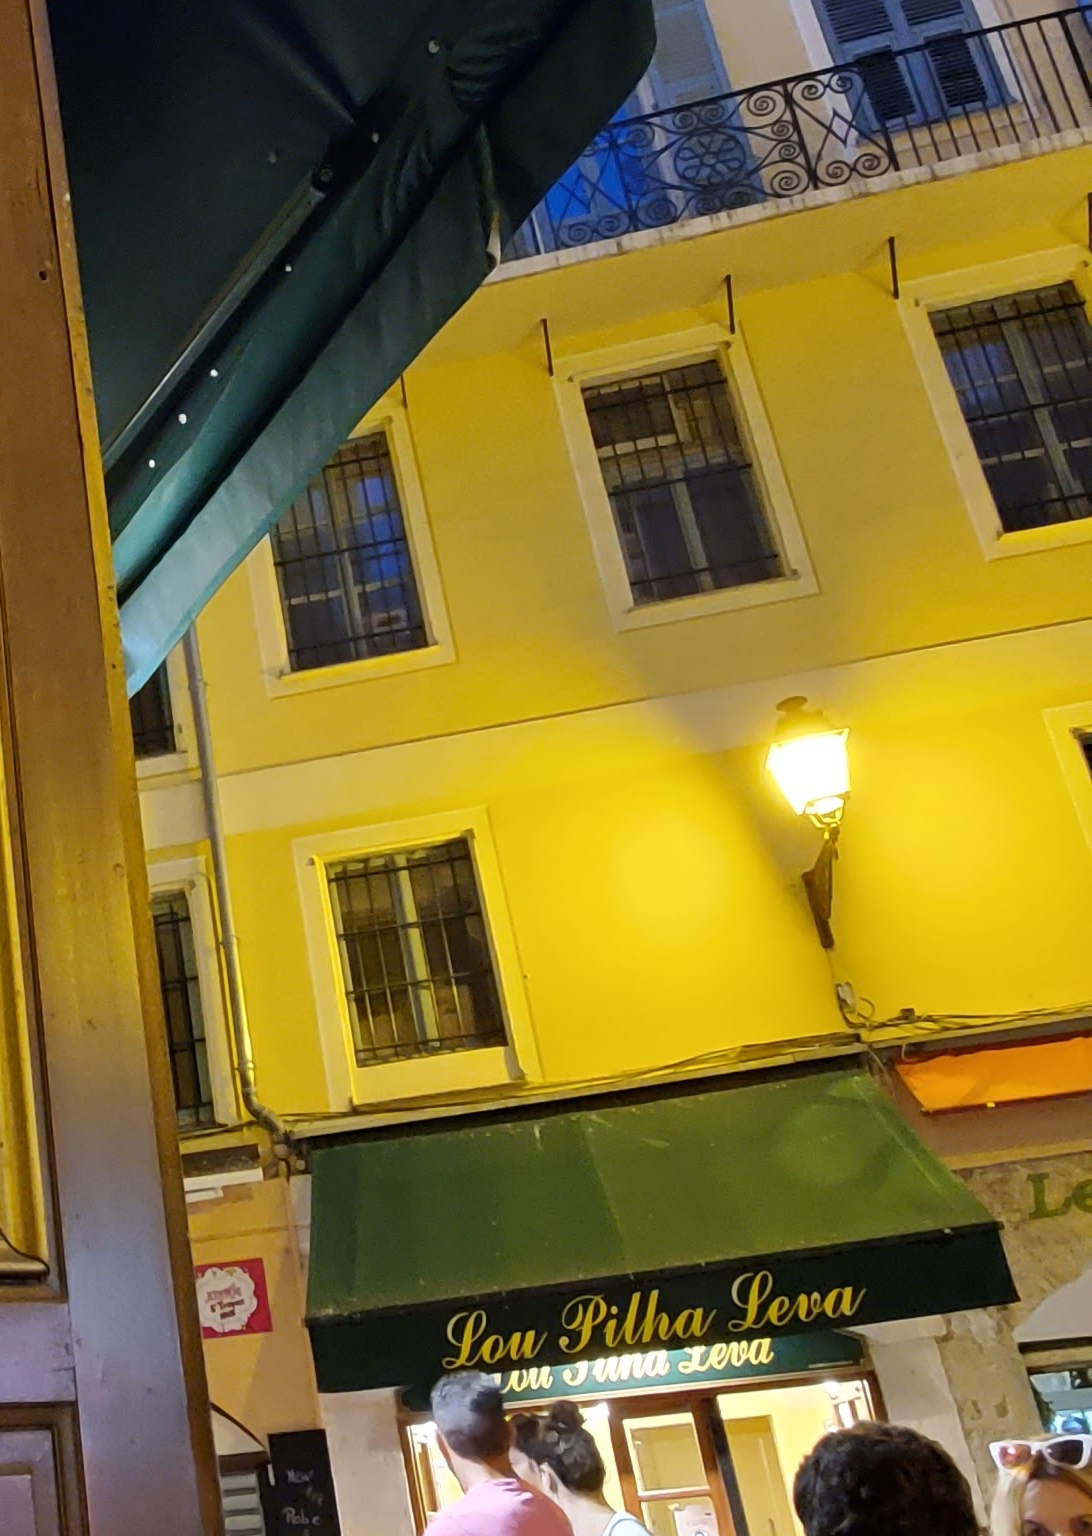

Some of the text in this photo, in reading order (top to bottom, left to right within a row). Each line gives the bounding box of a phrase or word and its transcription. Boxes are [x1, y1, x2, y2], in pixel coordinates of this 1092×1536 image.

[442, 1270, 867, 1369] Lou Pilha Leva
